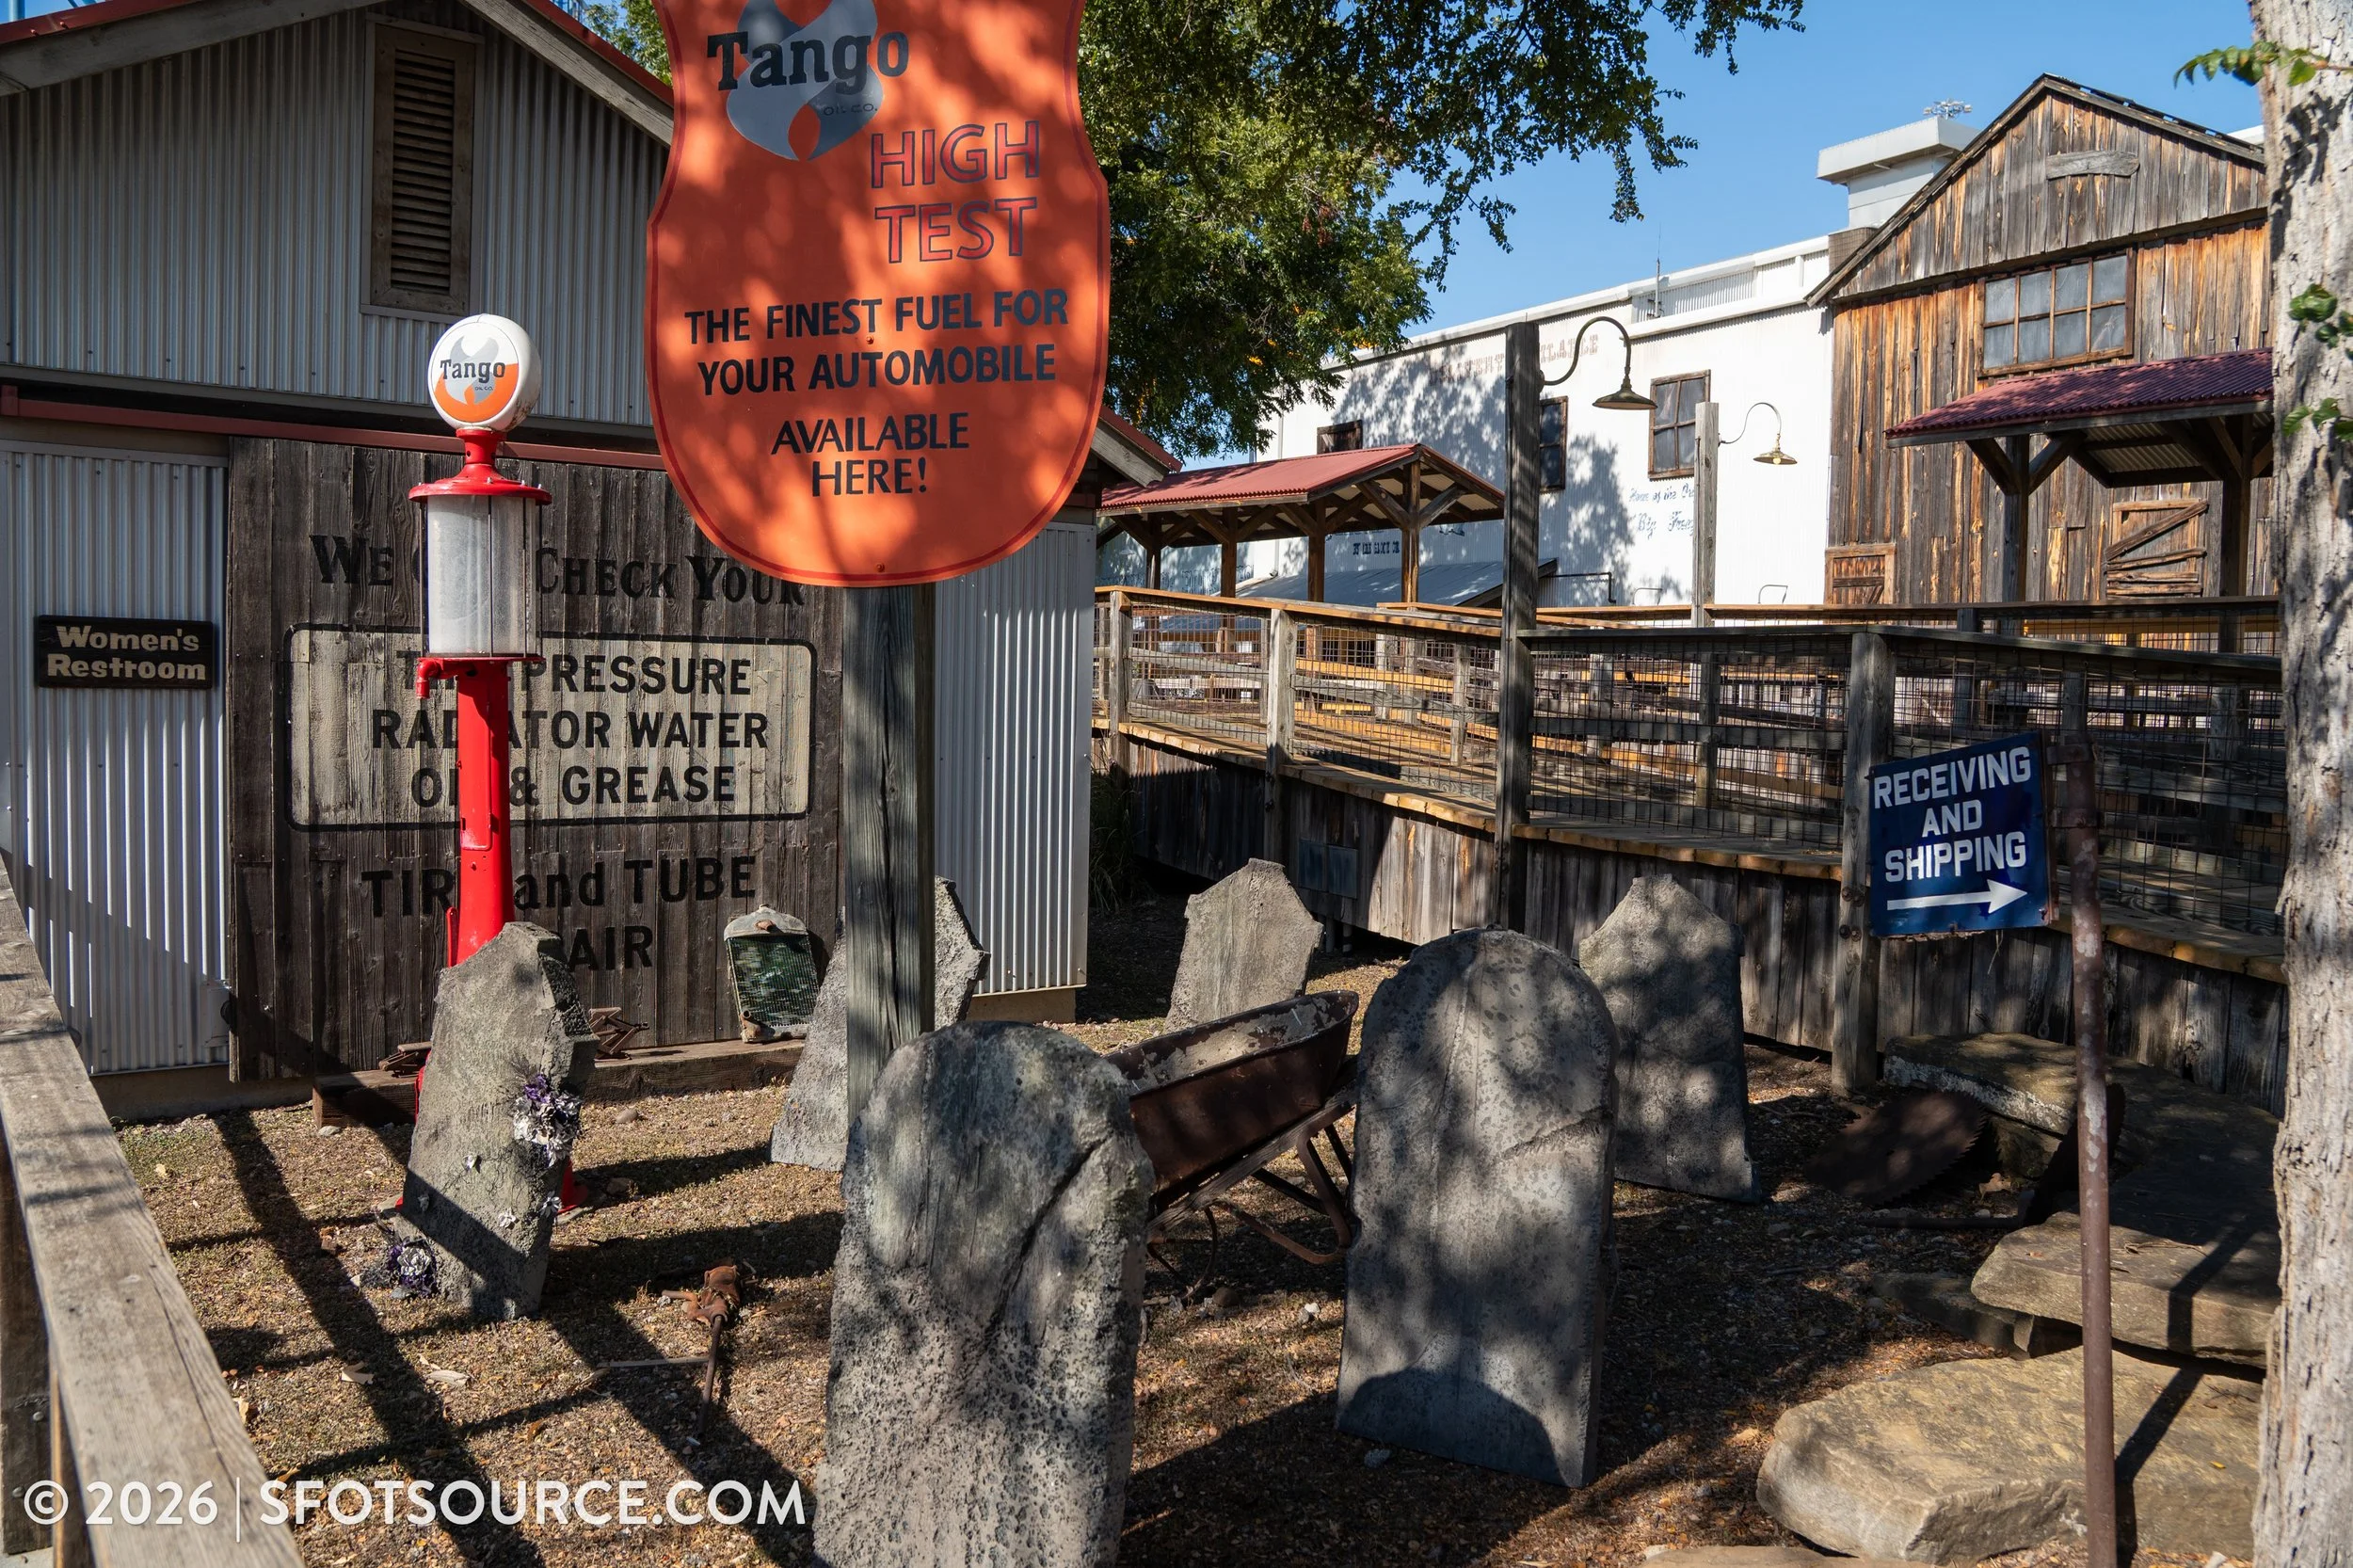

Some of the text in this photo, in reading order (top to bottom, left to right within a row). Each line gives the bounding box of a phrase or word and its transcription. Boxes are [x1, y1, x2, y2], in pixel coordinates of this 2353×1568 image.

[707, 31, 909, 94] Tango
[871, 120, 1040, 188] HIGH
[874, 197, 1038, 264] TEST
[684, 288, 1068, 344] THE FINEST FUEL FOR
[440, 359, 506, 384] Tango
[697, 344, 1056, 396] YOUR AUTOMOBILE
[771, 412, 969, 455] AVAILABLE
[812, 456, 927, 497] HERE!
[310, 534, 394, 586] WE
[535, 547, 677, 600] CHECK
[56, 625, 200, 651] Women's
[47, 653, 206, 680] Restroom
[521, 654, 751, 696] PRESSURE
[627, 712, 768, 749] WATER
[410, 764, 736, 808] OI & GREASE
[1873, 745, 2031, 809] RECEIVING
[1921, 799, 1982, 838] AND
[1884, 831, 2026, 883] SHIPPING
[361, 856, 757, 918] TIR and TUBE
[555, 925, 653, 973] AIR
